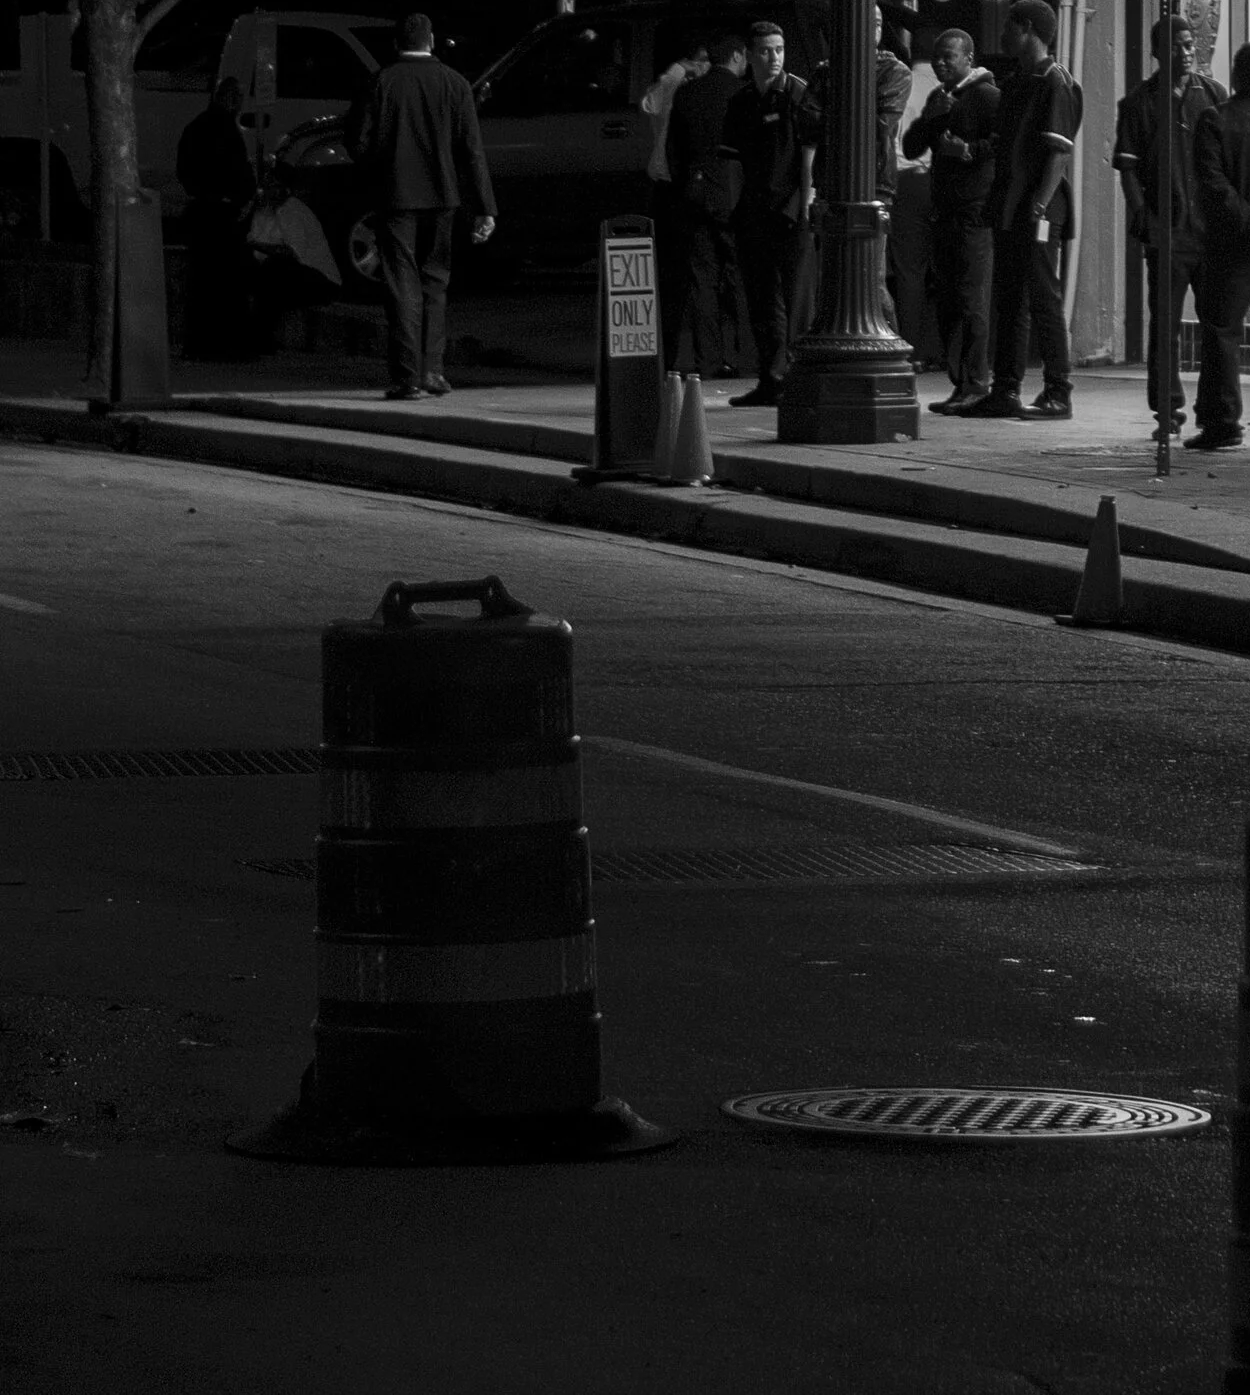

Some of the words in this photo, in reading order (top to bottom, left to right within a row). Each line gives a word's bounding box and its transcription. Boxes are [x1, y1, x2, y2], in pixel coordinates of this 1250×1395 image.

[609, 253, 652, 288] EXIT
[611, 299, 654, 327] ONLY
[611, 331, 655, 354] PLEASE
